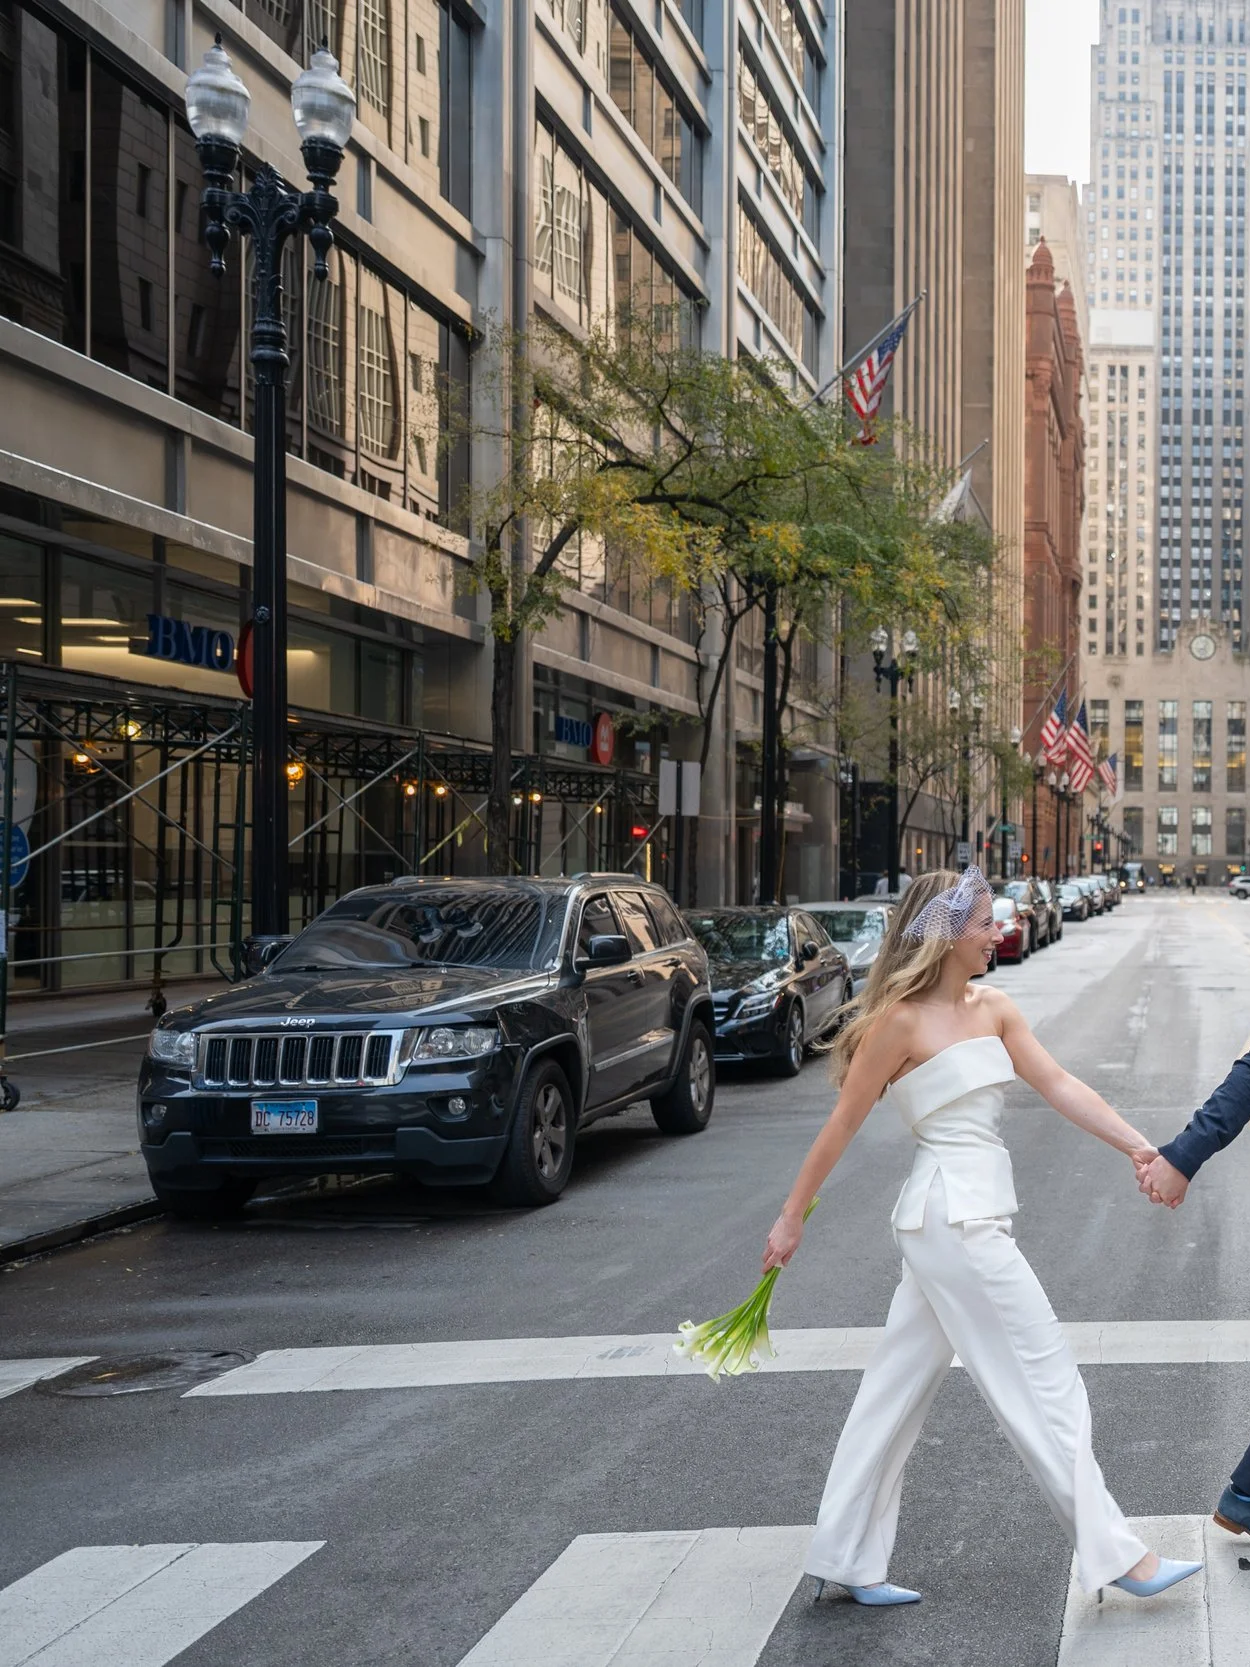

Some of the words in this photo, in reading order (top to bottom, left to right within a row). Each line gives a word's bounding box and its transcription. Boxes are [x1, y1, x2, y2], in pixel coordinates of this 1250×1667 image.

[156, 615, 235, 671] BMO
[562, 717, 593, 748] BMO
[280, 1017, 315, 1028] Jeep
[256, 1111, 271, 1127] DC
[278, 1110, 314, 1126] 75728
